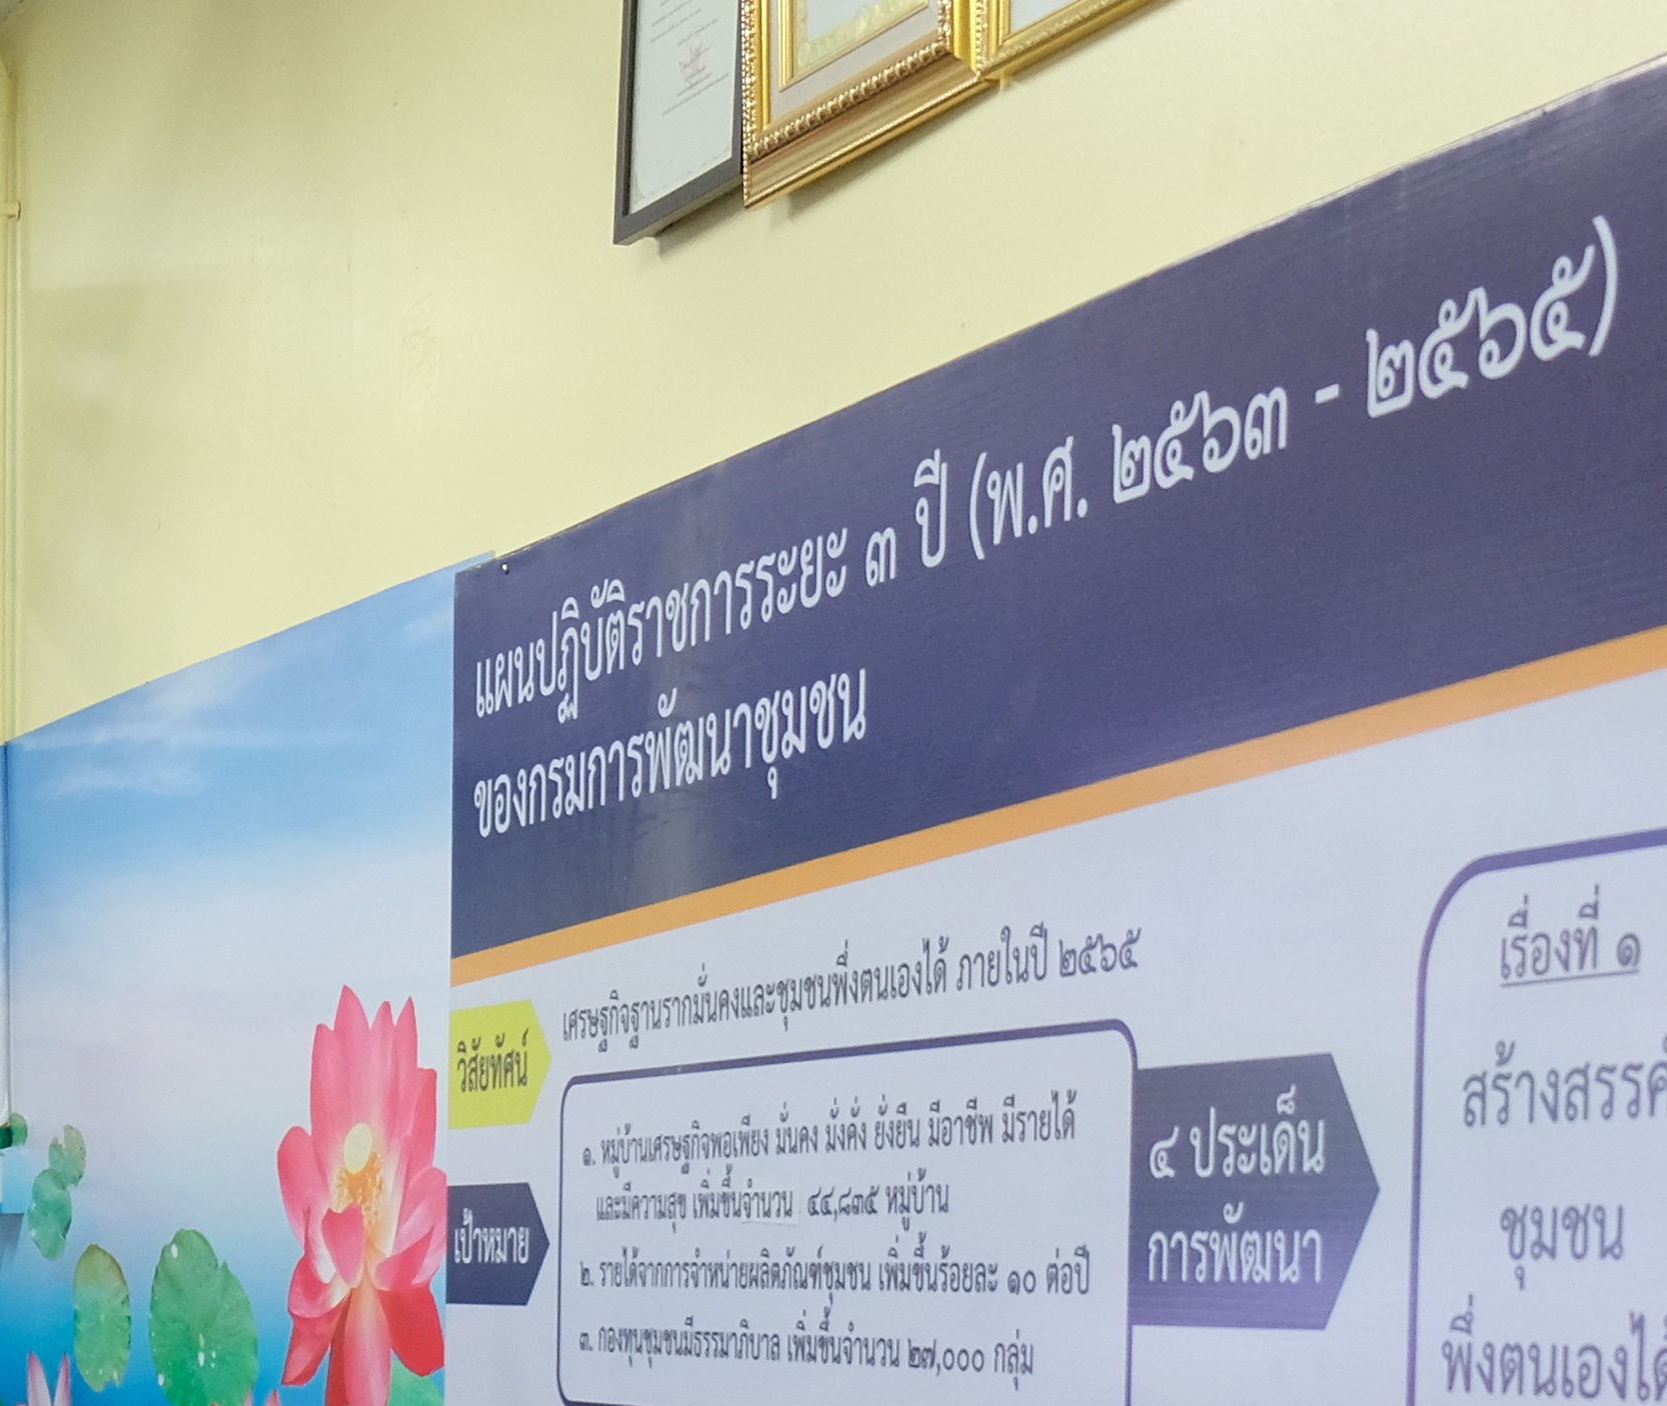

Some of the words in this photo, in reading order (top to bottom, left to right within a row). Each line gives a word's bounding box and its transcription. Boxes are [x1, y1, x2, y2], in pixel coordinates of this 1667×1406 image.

[473, 526, 851, 724] แผนปฏิบัติราชการระยะ
[865, 522, 900, 588] ๓
[914, 448, 950, 569] ปี
[970, 433, 1089, 560] (พ.ศ.
[1112, 386, 1289, 503] ๒๕๖๓
[1314, 382, 1341, 406] -
[1367, 213, 1621, 419] ๒๕๖๕)
[472, 668, 870, 840] ของกรมการพัฒนาชุมชน
[1499, 884, 1600, 981] เรื่องที่
[1616, 925, 1641, 971] ๑
[563, 936, 949, 1053] เศรษฐกิจฐานรากมั่นคงและชุมชนพึ่งตนเองได้
[956, 921, 1048, 992] ภายในปี
[1058, 926, 1142, 978] ๒๕๖๕
[457, 1028, 530, 1094] วิสัยทัศน์
[1463, 1034, 1667, 1128] สร้างสรรค
[600, 1114, 769, 1179] หมู่บ้านเศรษฐกิจพอเพียง
[775, 1101, 819, 1156] มั่นคง
[825, 1096, 868, 1153] มั่งคั่ง
[875, 1093, 921, 1150] ยั่งยืน
[927, 1096, 994, 1148] มีอาชีพ
[1001, 1089, 1077, 1144] มีรายได้
[1147, 1124, 1177, 1178] ๔
[1190, 1084, 1325, 1177] ประเด็น
[454, 1207, 530, 1265] เป้าหมาย
[596, 1180, 687, 1234] และมีความสุข
[693, 1163, 794, 1221] เพิ่มขึ้นจำนวน
[885, 1167, 950, 1232] หมู่บ้าน
[1147, 1201, 1324, 1284] การพัฒนา
[599, 1245, 872, 1307] รายได้จากการจำหน่ายผลิตภัณฑ์ชุมชน
[878, 1231, 998, 1294] เพิ่มขึ้นร้อยละ
[1006, 1268, 1037, 1296] ๑๐
[1046, 1245, 1091, 1296] ต่อปี
[1499, 1203, 1624, 1290] ชุมชน
[598, 1315, 781, 1369] กองทุนชุมชนมีธรรมาภิบาล
[787, 1305, 900, 1368] เพิ่มขึ้นจำนวน
[907, 1337, 986, 1377] ๒๗,๐๐๐
[994, 1328, 1035, 1392] กลุ่ม
[1441, 1292, 1667, 1402] พึ่งตนเองได
